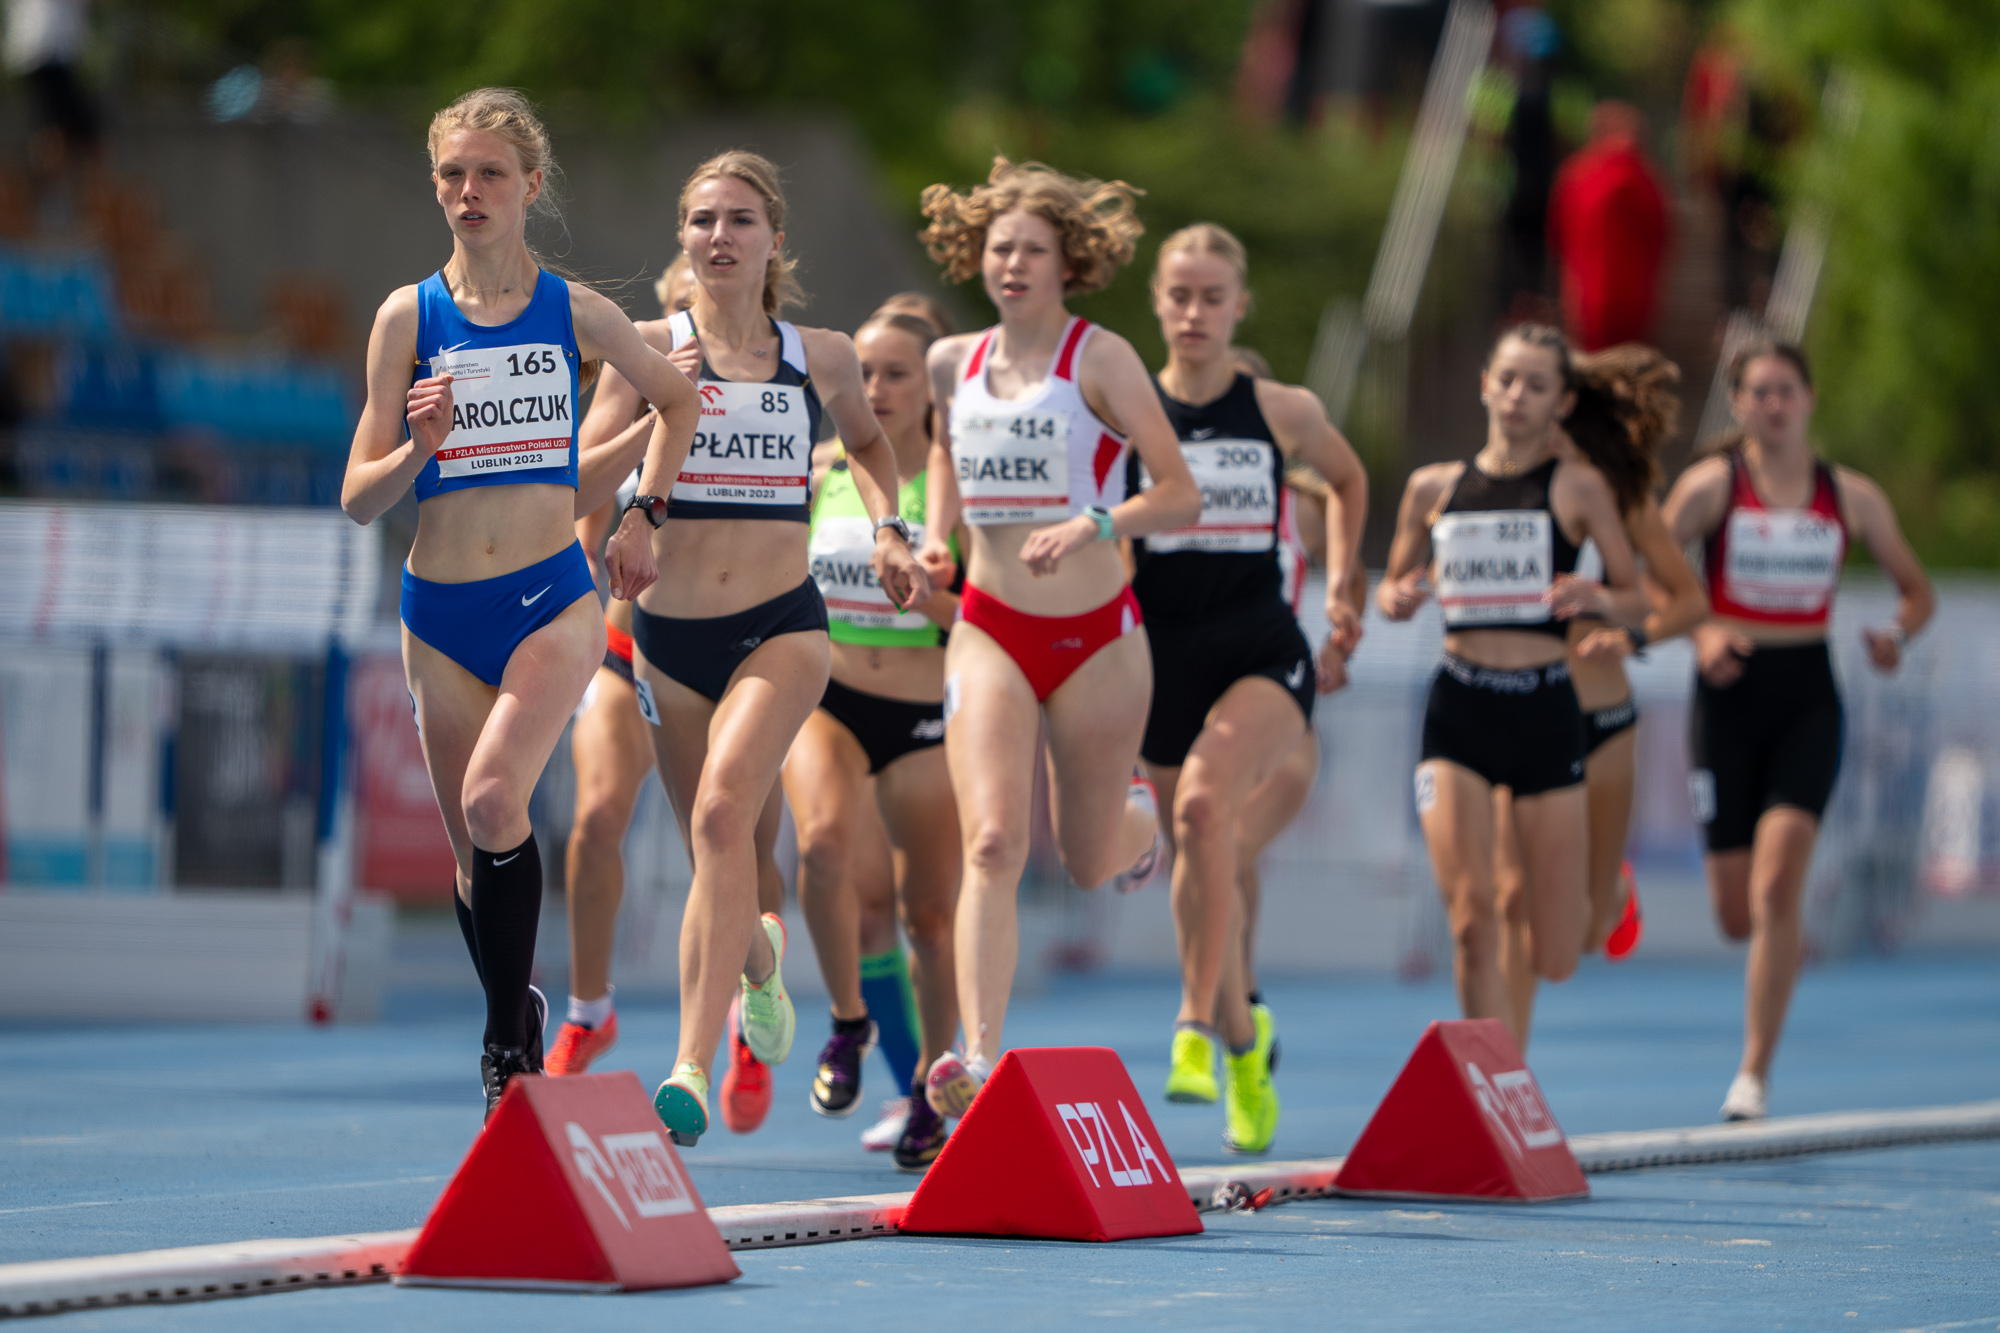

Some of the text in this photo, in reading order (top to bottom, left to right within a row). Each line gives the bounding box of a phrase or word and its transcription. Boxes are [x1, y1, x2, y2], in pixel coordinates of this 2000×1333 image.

[467, 367, 491, 375] Turystyki
[507, 350, 556, 377] 165
[451, 393, 569, 431] AROLCZUK
[700, 408, 726, 416] RLEN
[761, 391, 789, 413] 85
[1009, 416, 1055, 439] 414
[444, 439, 567, 459] 77. PZLA Mistrzostwa Polski U20
[689, 432, 796, 460] PŁATEK
[1215, 446, 1261, 469] 200
[471, 453, 543, 469] LUBLIN 2023
[960, 456, 1050, 481] BIAŁEK
[706, 487, 776, 498] LUBLIN 2023
[1201, 485, 1268, 510] OWSKA
[811, 560, 883, 588] PAWE
[1056, 1100, 1172, 1188] PZLA
